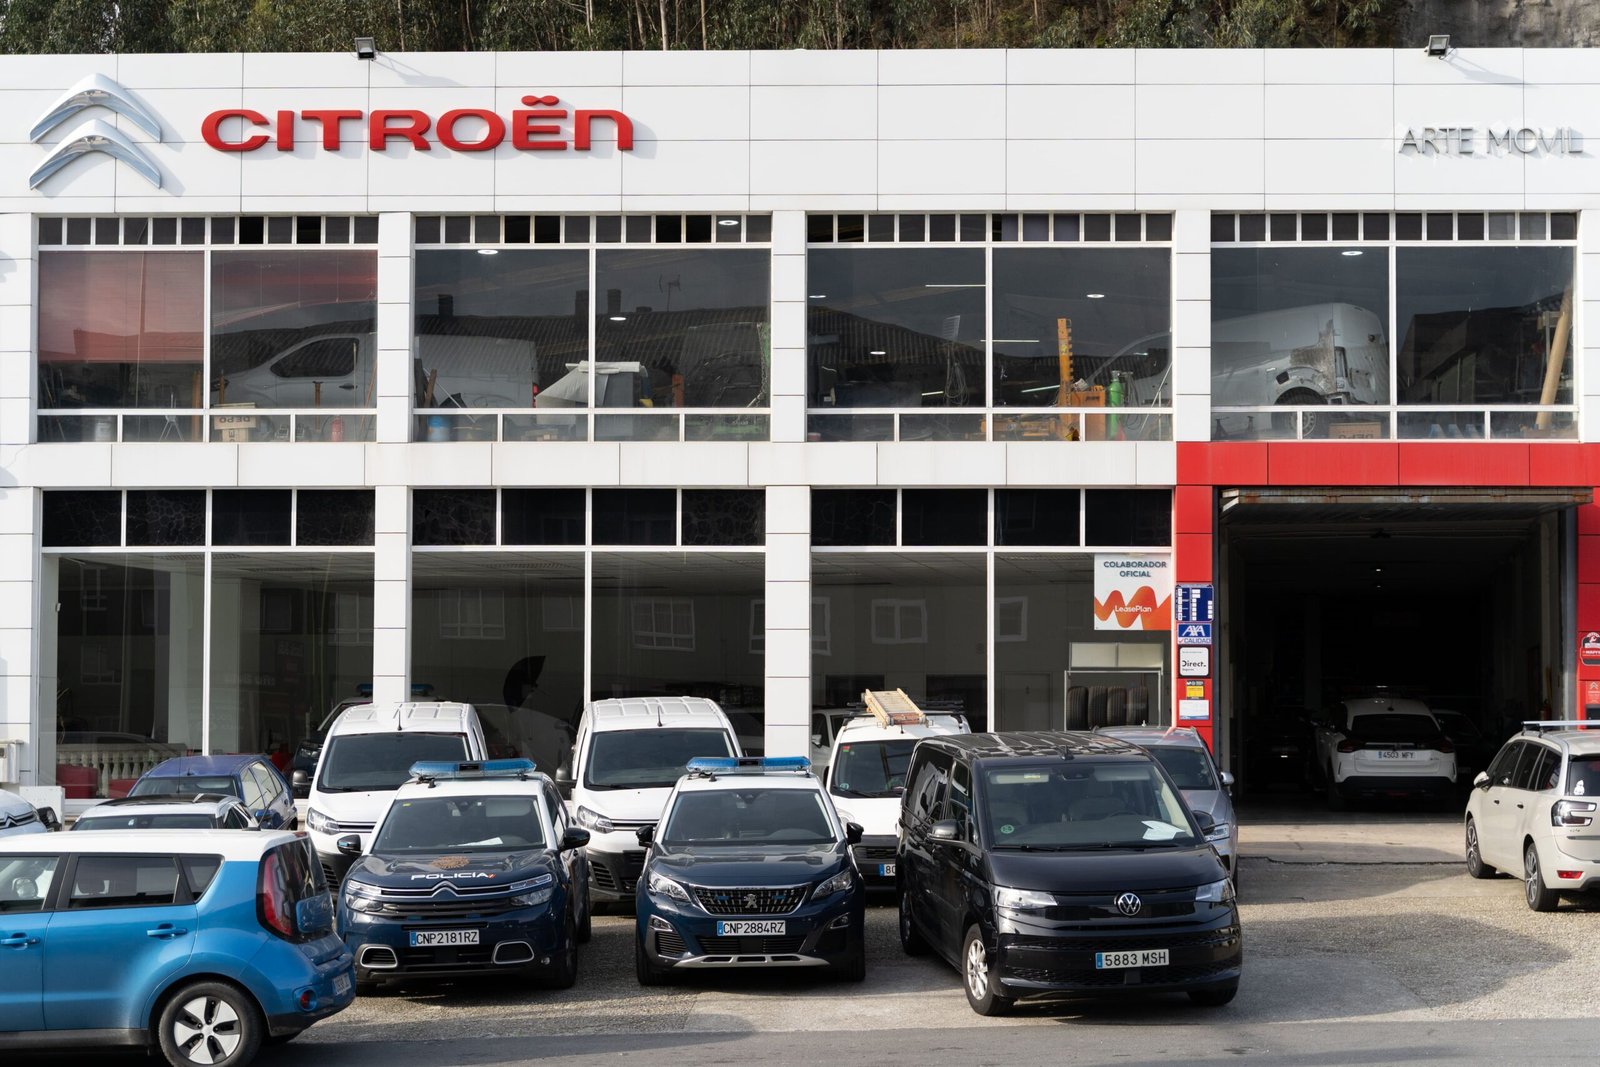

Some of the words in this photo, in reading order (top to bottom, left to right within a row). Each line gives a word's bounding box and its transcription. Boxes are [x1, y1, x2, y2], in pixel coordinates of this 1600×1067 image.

[201, 95, 634, 151] CITROËN
[1398, 127, 1474, 154] ARTE
[1487, 127, 1583, 154] MOVIL
[1119, 570, 1152, 578] OFICIAL
[1114, 605, 1152, 613] LeasePlan
[1181, 625, 1206, 637] AXA
[723, 922, 785, 934] CNP2884RZ
[416, 931, 478, 945] CNP2181RZ
[1104, 953, 1138, 967] 5883
[1142, 951, 1166, 965] MSH
